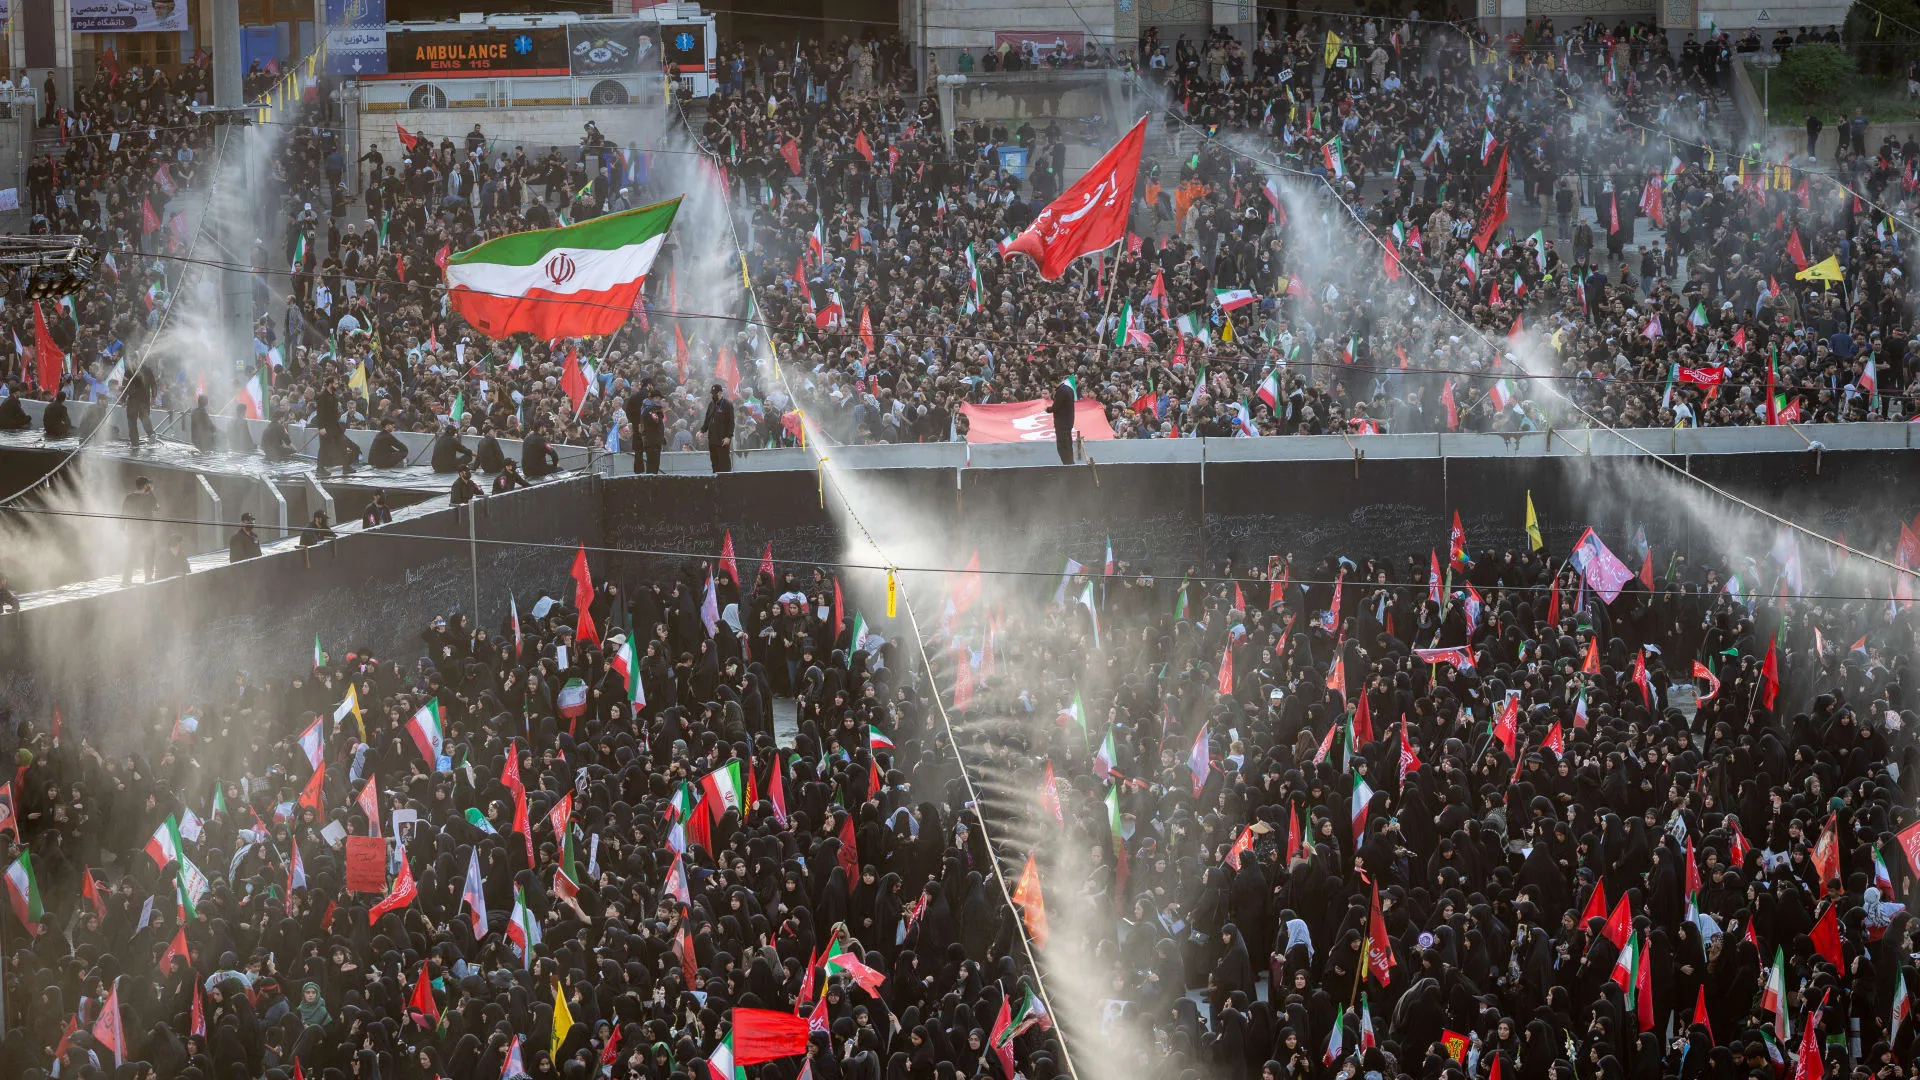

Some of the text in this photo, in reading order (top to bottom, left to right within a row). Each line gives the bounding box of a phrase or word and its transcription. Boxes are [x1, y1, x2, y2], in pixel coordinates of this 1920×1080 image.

[76, 3, 148, 15] بیمارستان تخصصی
[76, 20, 96, 28] علوم
[97, 19, 125, 27] دانشگاه
[344, 34, 363, 45] توزیع
[363, 34, 380, 44] محل
[415, 43, 507, 60] AMBULANCE
[430, 60, 491, 69] EMS 115
